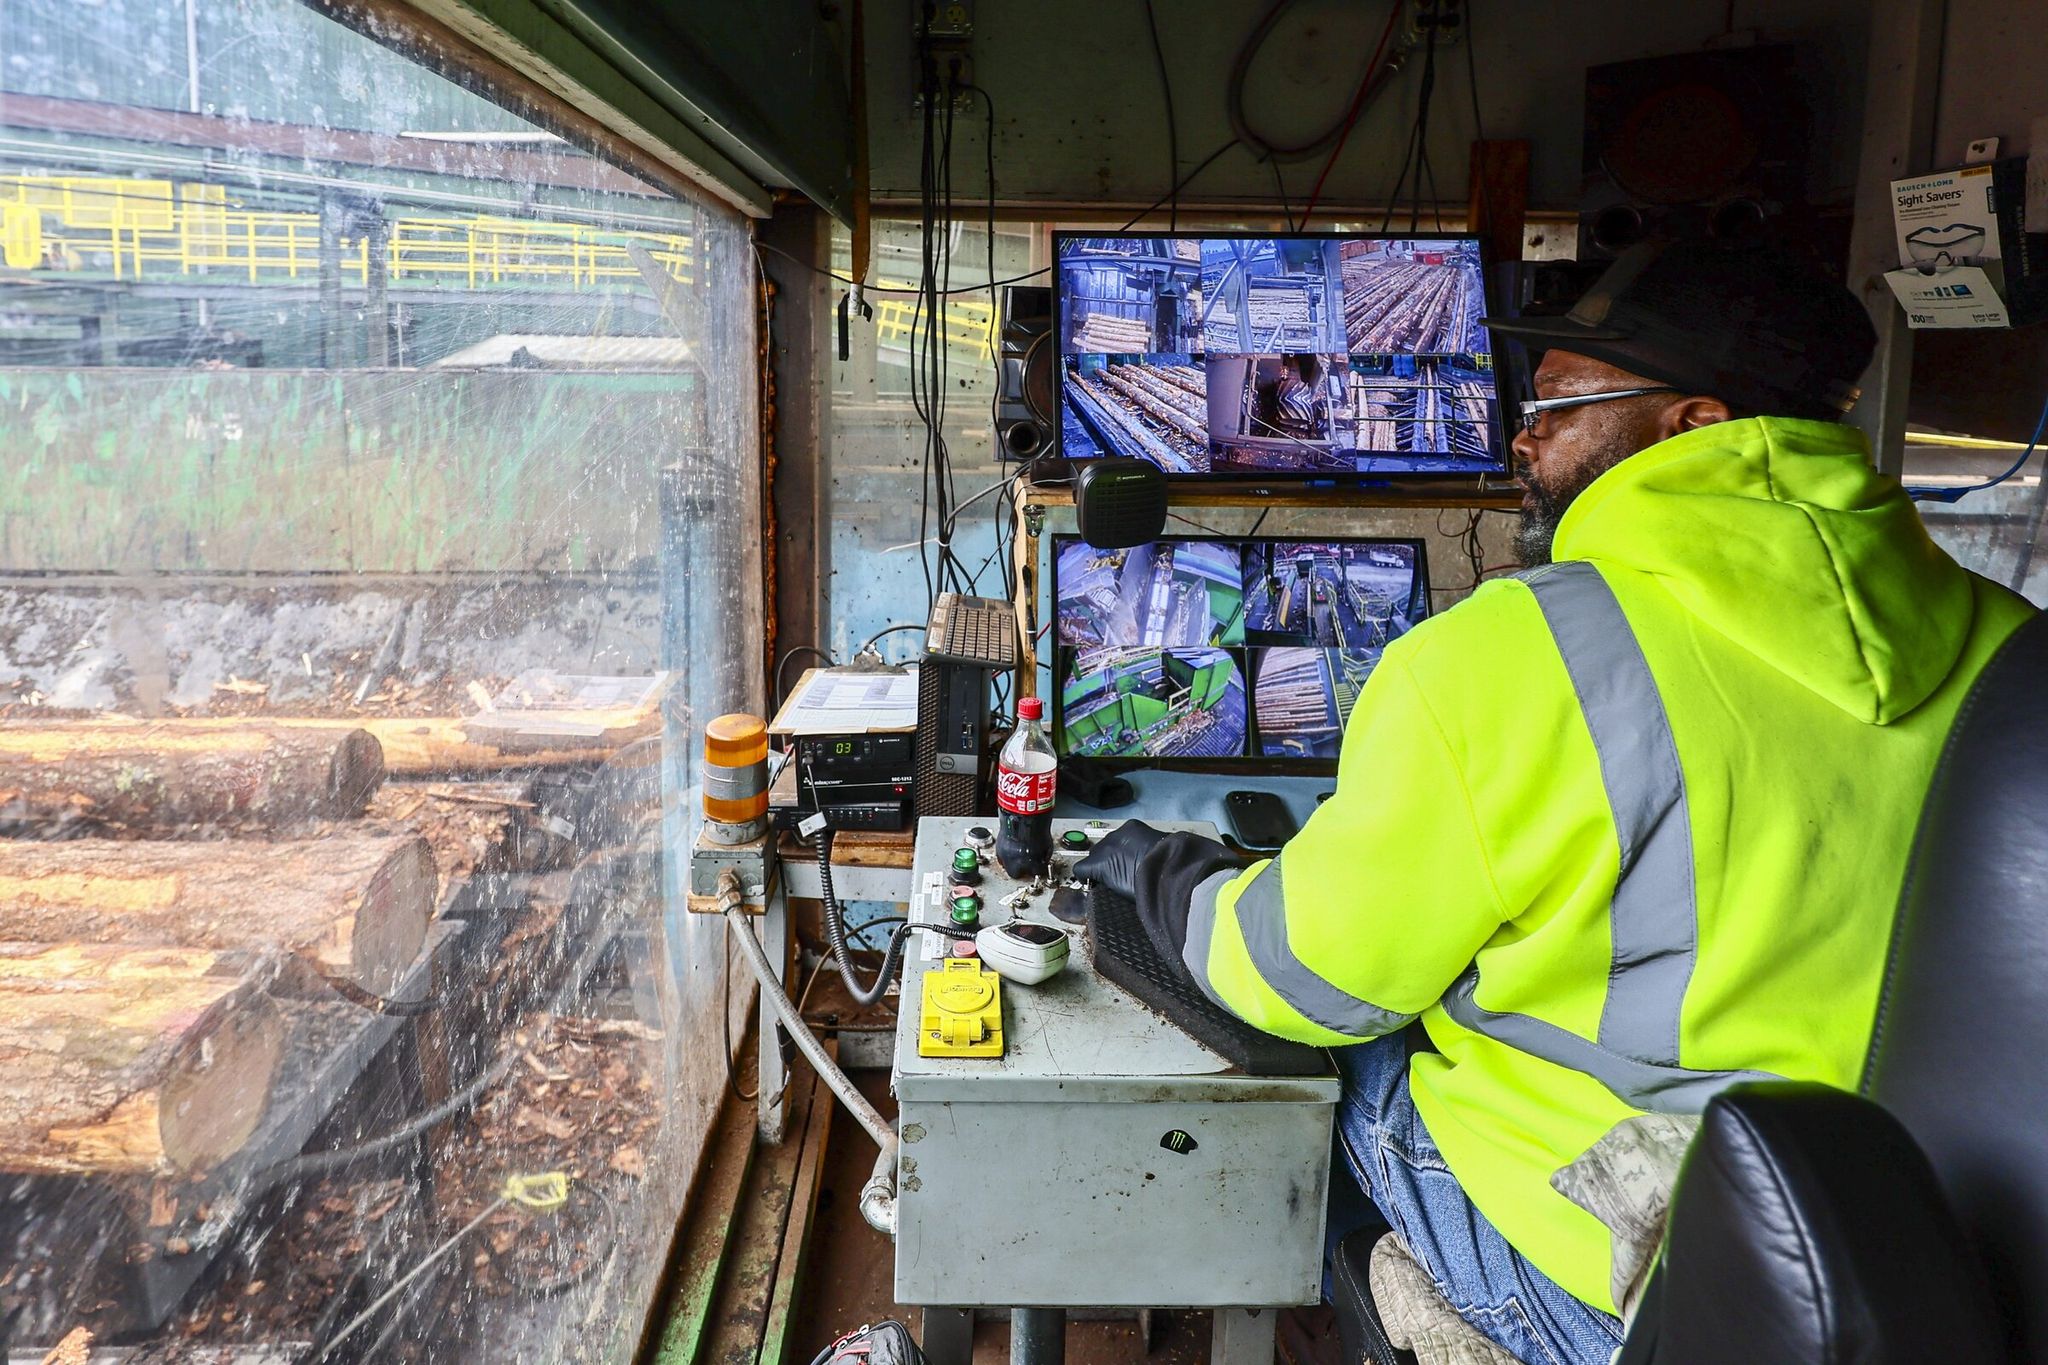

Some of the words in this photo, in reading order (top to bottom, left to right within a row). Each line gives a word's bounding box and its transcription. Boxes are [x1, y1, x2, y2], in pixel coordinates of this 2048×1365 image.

[1897, 182, 1926, 193] BAUSCH
[1932, 179, 1954, 187] LOMB
[1897, 193, 1924, 208] Sight
[1926, 190, 1962, 203] Savers
[1910, 314, 1926, 324] 100
[836, 743, 852, 754] 03
